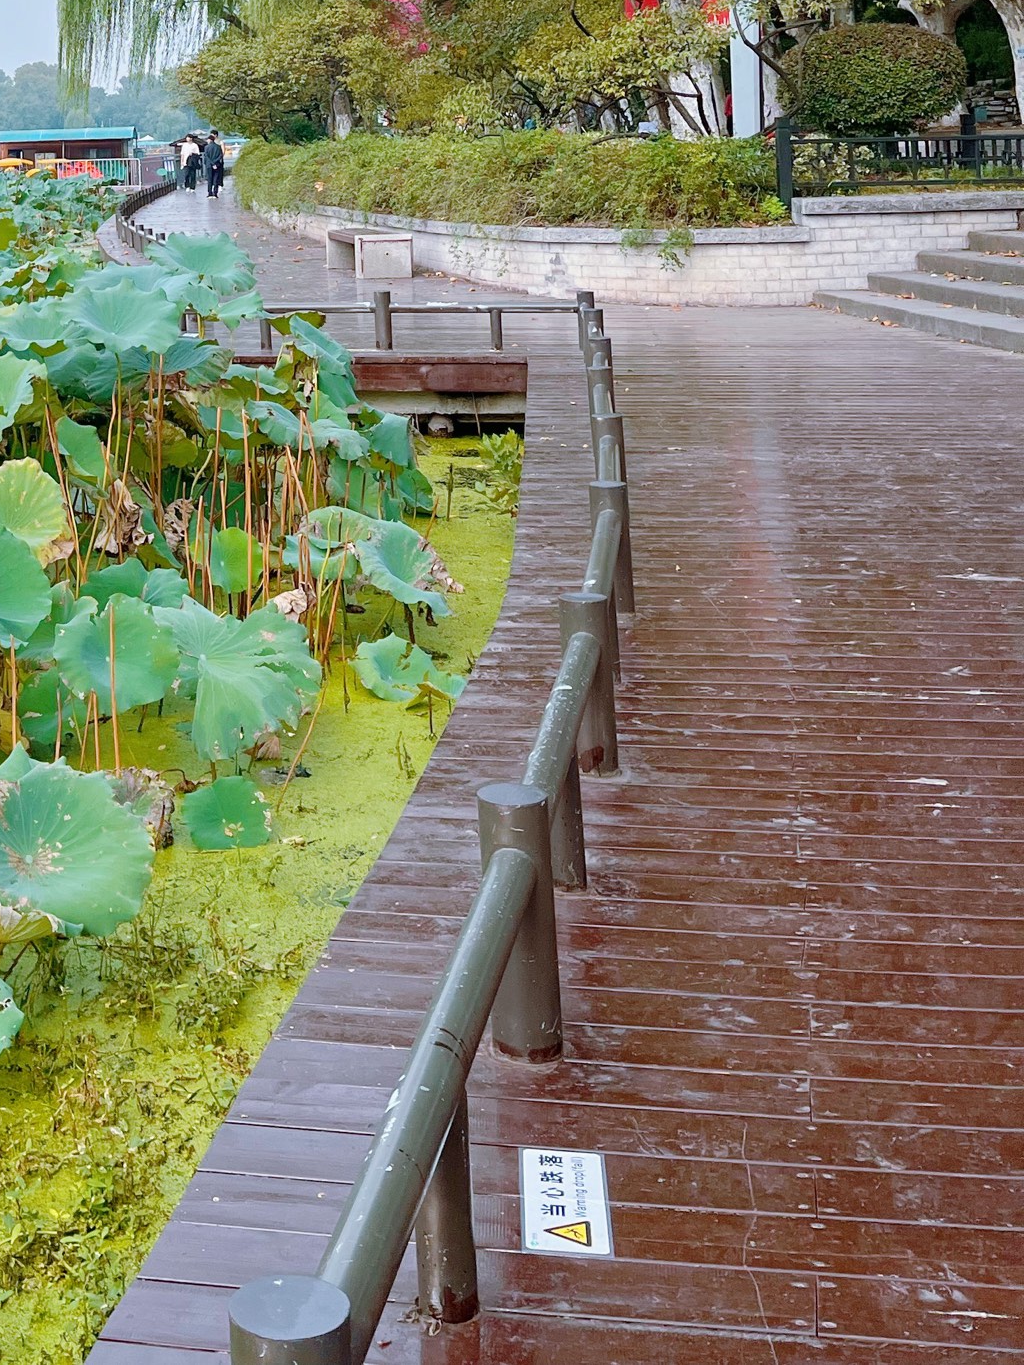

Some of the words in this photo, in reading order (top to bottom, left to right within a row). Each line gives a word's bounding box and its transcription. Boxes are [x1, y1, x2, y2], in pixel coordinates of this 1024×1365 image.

[538, 1154, 566, 1217] 当心跌落
[573, 1188, 587, 1218] Warning
